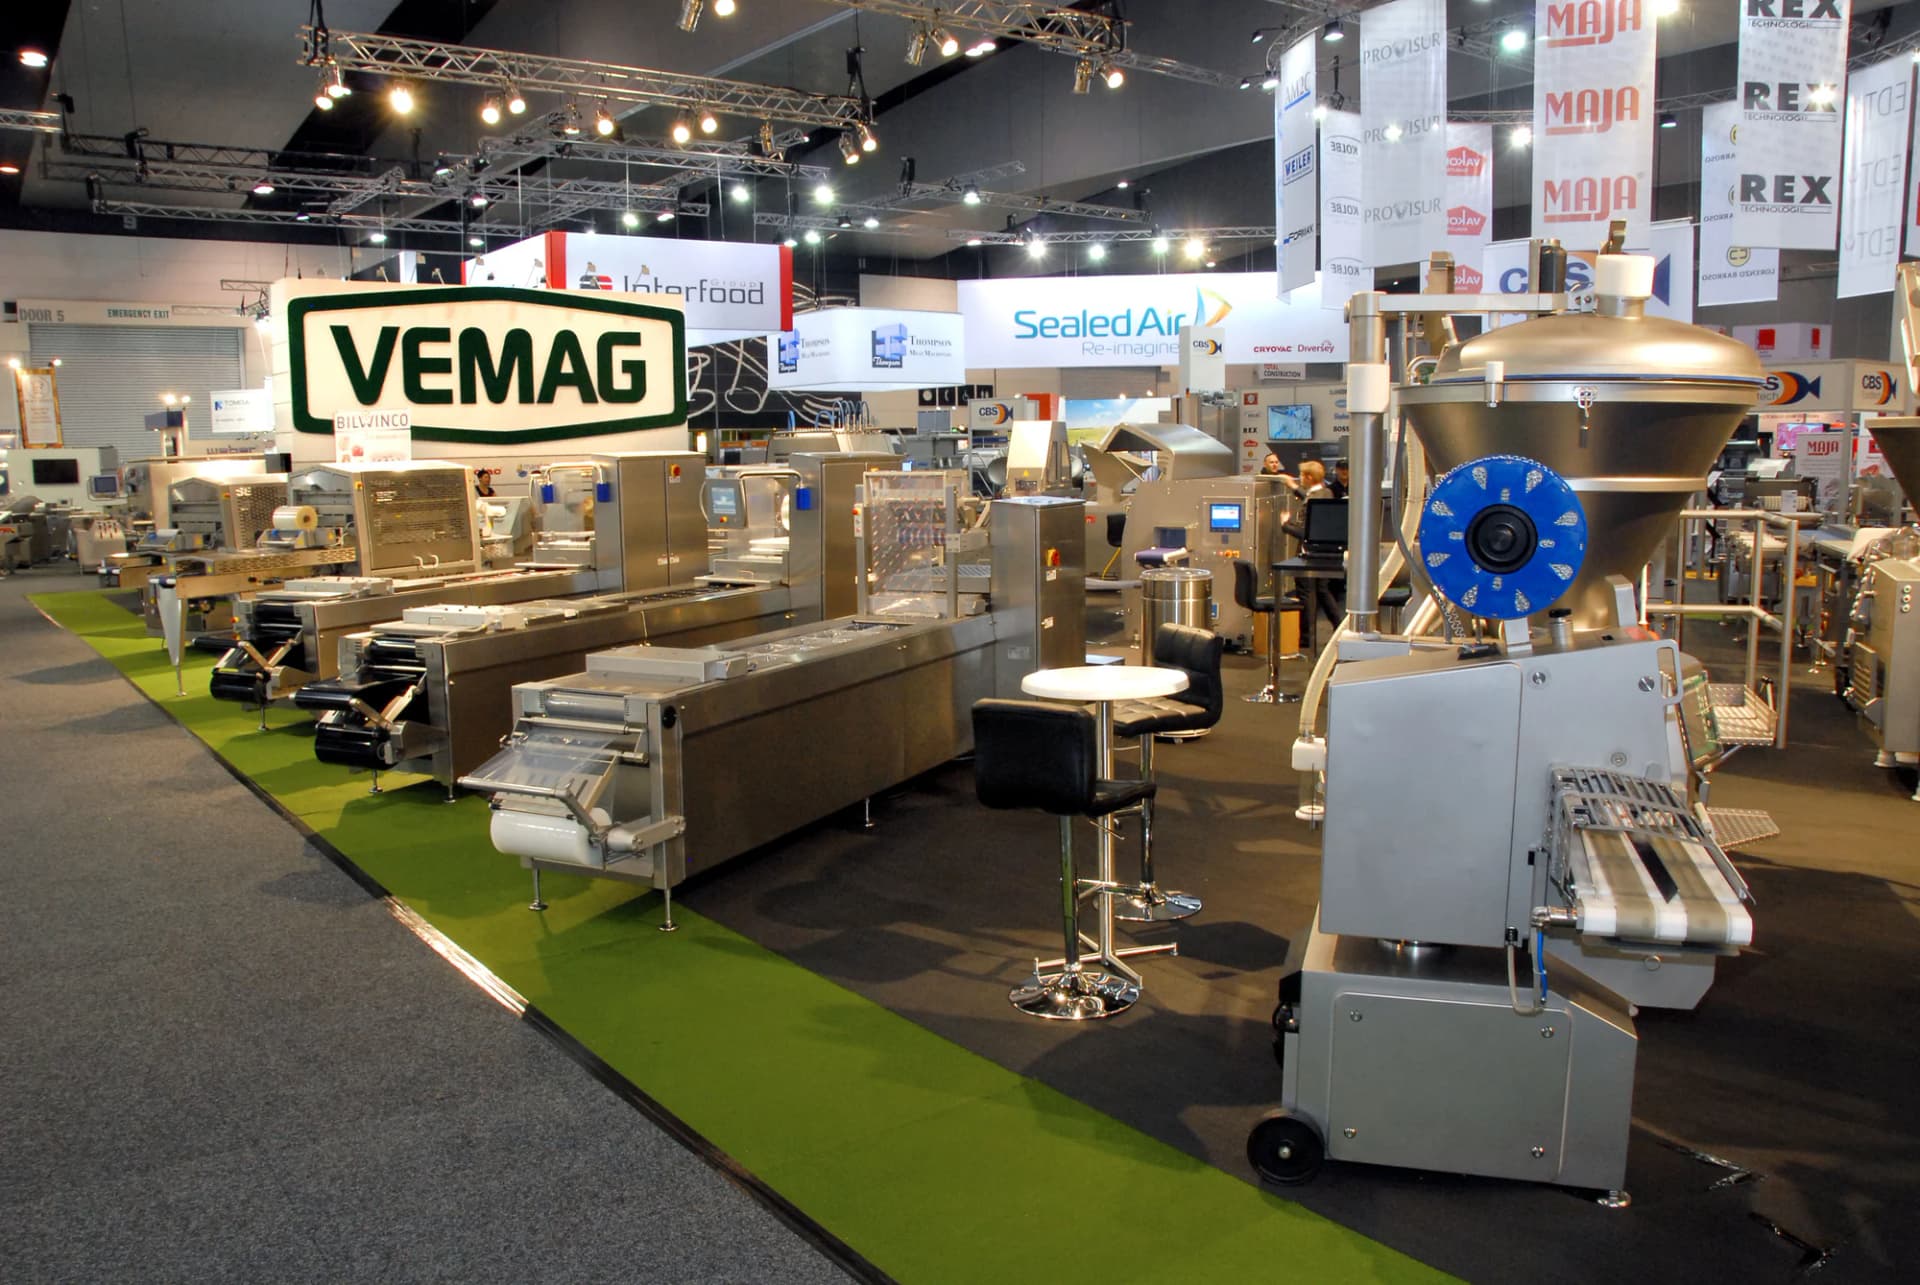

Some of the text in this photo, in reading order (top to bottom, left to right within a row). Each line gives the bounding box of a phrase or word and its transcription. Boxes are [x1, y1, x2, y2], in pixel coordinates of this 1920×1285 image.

[1547, 0, 1642, 45] MAJA
[1363, 32, 1440, 64] PROVISUR
[1743, 82, 1837, 112] REX
[1545, 86, 1640, 135] MAJA
[1285, 151, 1312, 177] WEILER
[1543, 175, 1637, 223] MAJA
[1740, 174, 1832, 204] REX
[1364, 198, 1442, 224] PROVISUR
[1499, 262, 1596, 294] CS
[19, 308, 65, 322] DOOR 5
[107, 308, 169, 319] EMERGENCY EXIT
[1014, 307, 1186, 339] Sealed Air
[1193, 340, 1210, 348] CBS
[1297, 342, 1335, 354] Diversey
[329, 325, 647, 405] VEMAG
[1862, 375, 1882, 390] CBS
[336, 412, 409, 429] BILWINCO
[979, 406, 998, 416] CBS
[1808, 440, 1839, 456] MAJA
